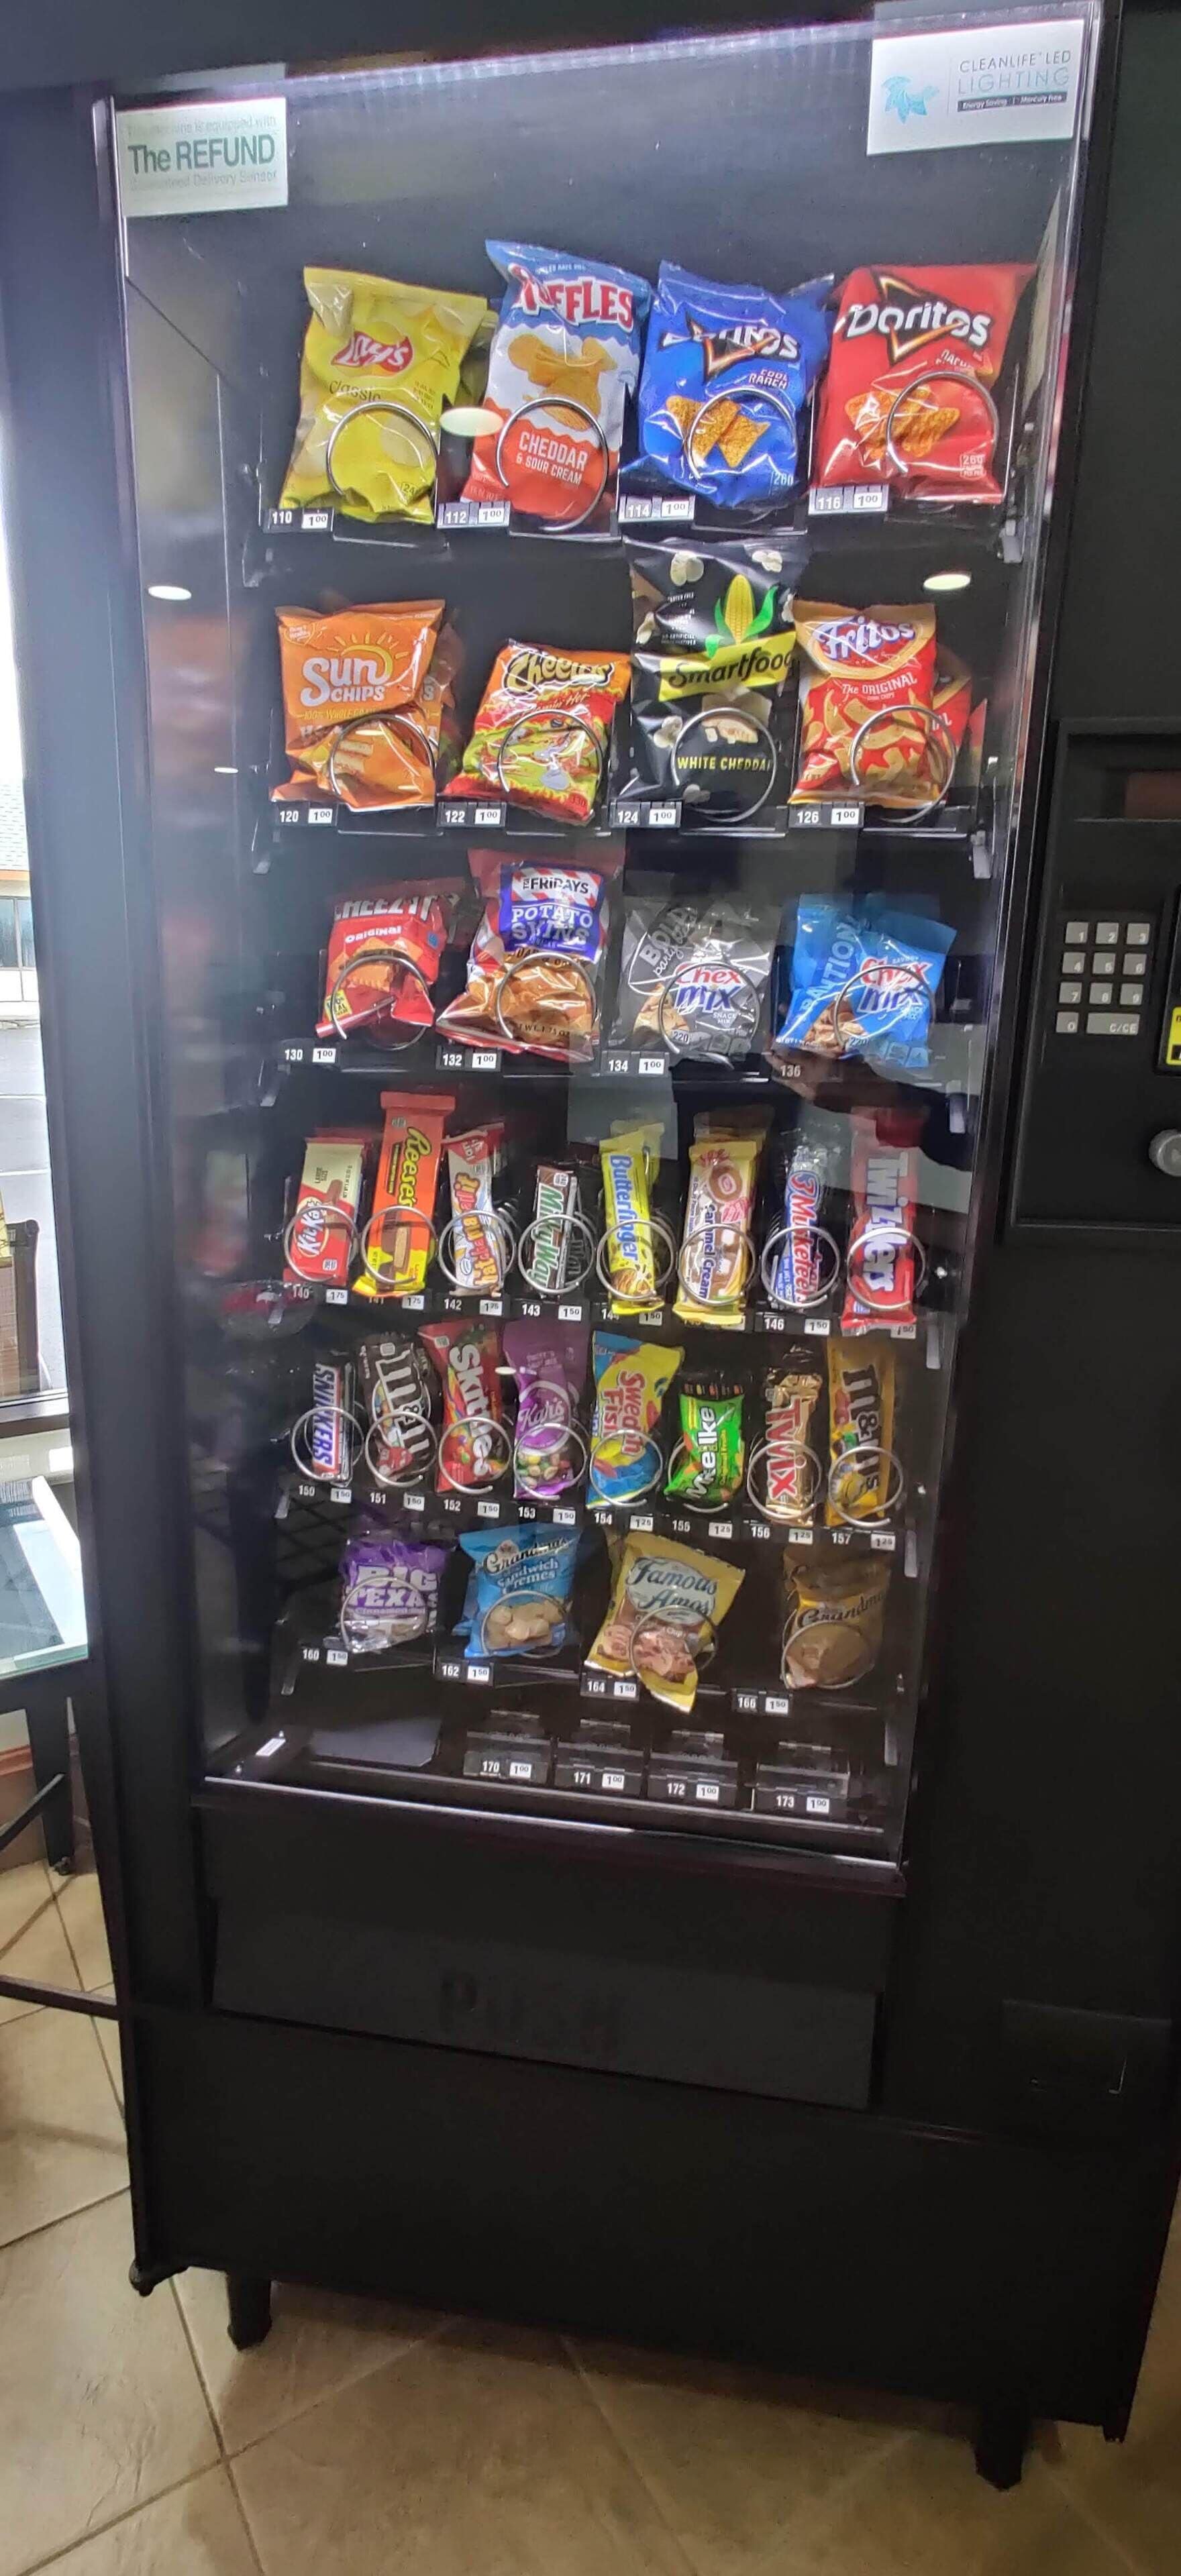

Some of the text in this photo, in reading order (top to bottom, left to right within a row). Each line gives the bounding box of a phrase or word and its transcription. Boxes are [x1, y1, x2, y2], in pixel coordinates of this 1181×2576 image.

[1046, 50, 1072, 64] LED
[958, 66, 1069, 95] LIGHTING
[962, 100, 984, 111] Energy
[127, 133, 276, 174] The REFUND
[846, 301, 992, 347] Doritos
[338, 332, 410, 370] Lay's
[749, 373, 788, 390] RANCH
[760, 369, 788, 382] COOL
[519, 431, 588, 471] CHEDDAR
[525, 457, 549, 474] SOUR
[550, 464, 583, 485] CREAM
[817, 496, 841, 510] 116
[272, 511, 293, 525] 110
[445, 511, 467, 525] 112
[627, 504, 650, 518] 114
[814, 615, 915, 660] Fritos
[301, 654, 393, 706] Sun
[841, 672, 918, 699] The ORIGINAL
[329, 685, 386, 702] CHIPS
[677, 756, 716, 770] WHITE
[280, 810, 299, 823] 120
[445, 810, 465, 823] 122
[617, 810, 638, 824] 124
[797, 810, 819, 824] 126
[511, 904, 594, 928] POTATO
[1078, 932, 1085, 941] 1
[1107, 932, 1116, 942] 2
[674, 961, 742, 984] Chex
[1074, 961, 1081, 972] 4
[1135, 963, 1143, 973] 6
[676, 983, 741, 1014] Mix
[1072, 991, 1079, 1002] 7
[1101, 993, 1109, 1002] 8
[1109, 1023, 1138, 1034] C/CE
[674, 1031, 689, 1043] 220
[285, 1049, 303, 1061] 130
[443, 1055, 462, 1067] 132
[609, 1059, 629, 1072] 134
[780, 1065, 801, 1078] 136
[790, 1175, 815, 1195] 3
[527, 1242, 560, 1288] Way
[699, 1258, 716, 1300] Cream
[444, 1298, 462, 1310] 142
[521, 1303, 540, 1317] 143
[764, 1318, 784, 1331] 146
[765, 1395, 808, 1500] Twix
[299, 1485, 315, 1497] 150
[370, 1492, 387, 1504] 151
[444, 1499, 462, 1511] 152
[517, 1507, 536, 1519] 153
[594, 1513, 613, 1525] 154
[672, 1519, 691, 1532] 155
[750, 1526, 771, 1539] 156
[831, 1532, 852, 1545] 157
[356, 1565, 438, 1592] BIG
[625, 1556, 717, 1595] Famous
[638, 1588, 710, 1615] Amos
[302, 1648, 320, 1661] 160
[442, 1666, 460, 1677] 162
[587, 1680, 605, 1693] 164
[737, 1697, 757, 1709] 166
[481, 1760, 500, 1773] 170
[573, 1771, 592, 1785] 171
[666, 1782, 686, 1796] 172
[776, 1794, 794, 1809] 173
